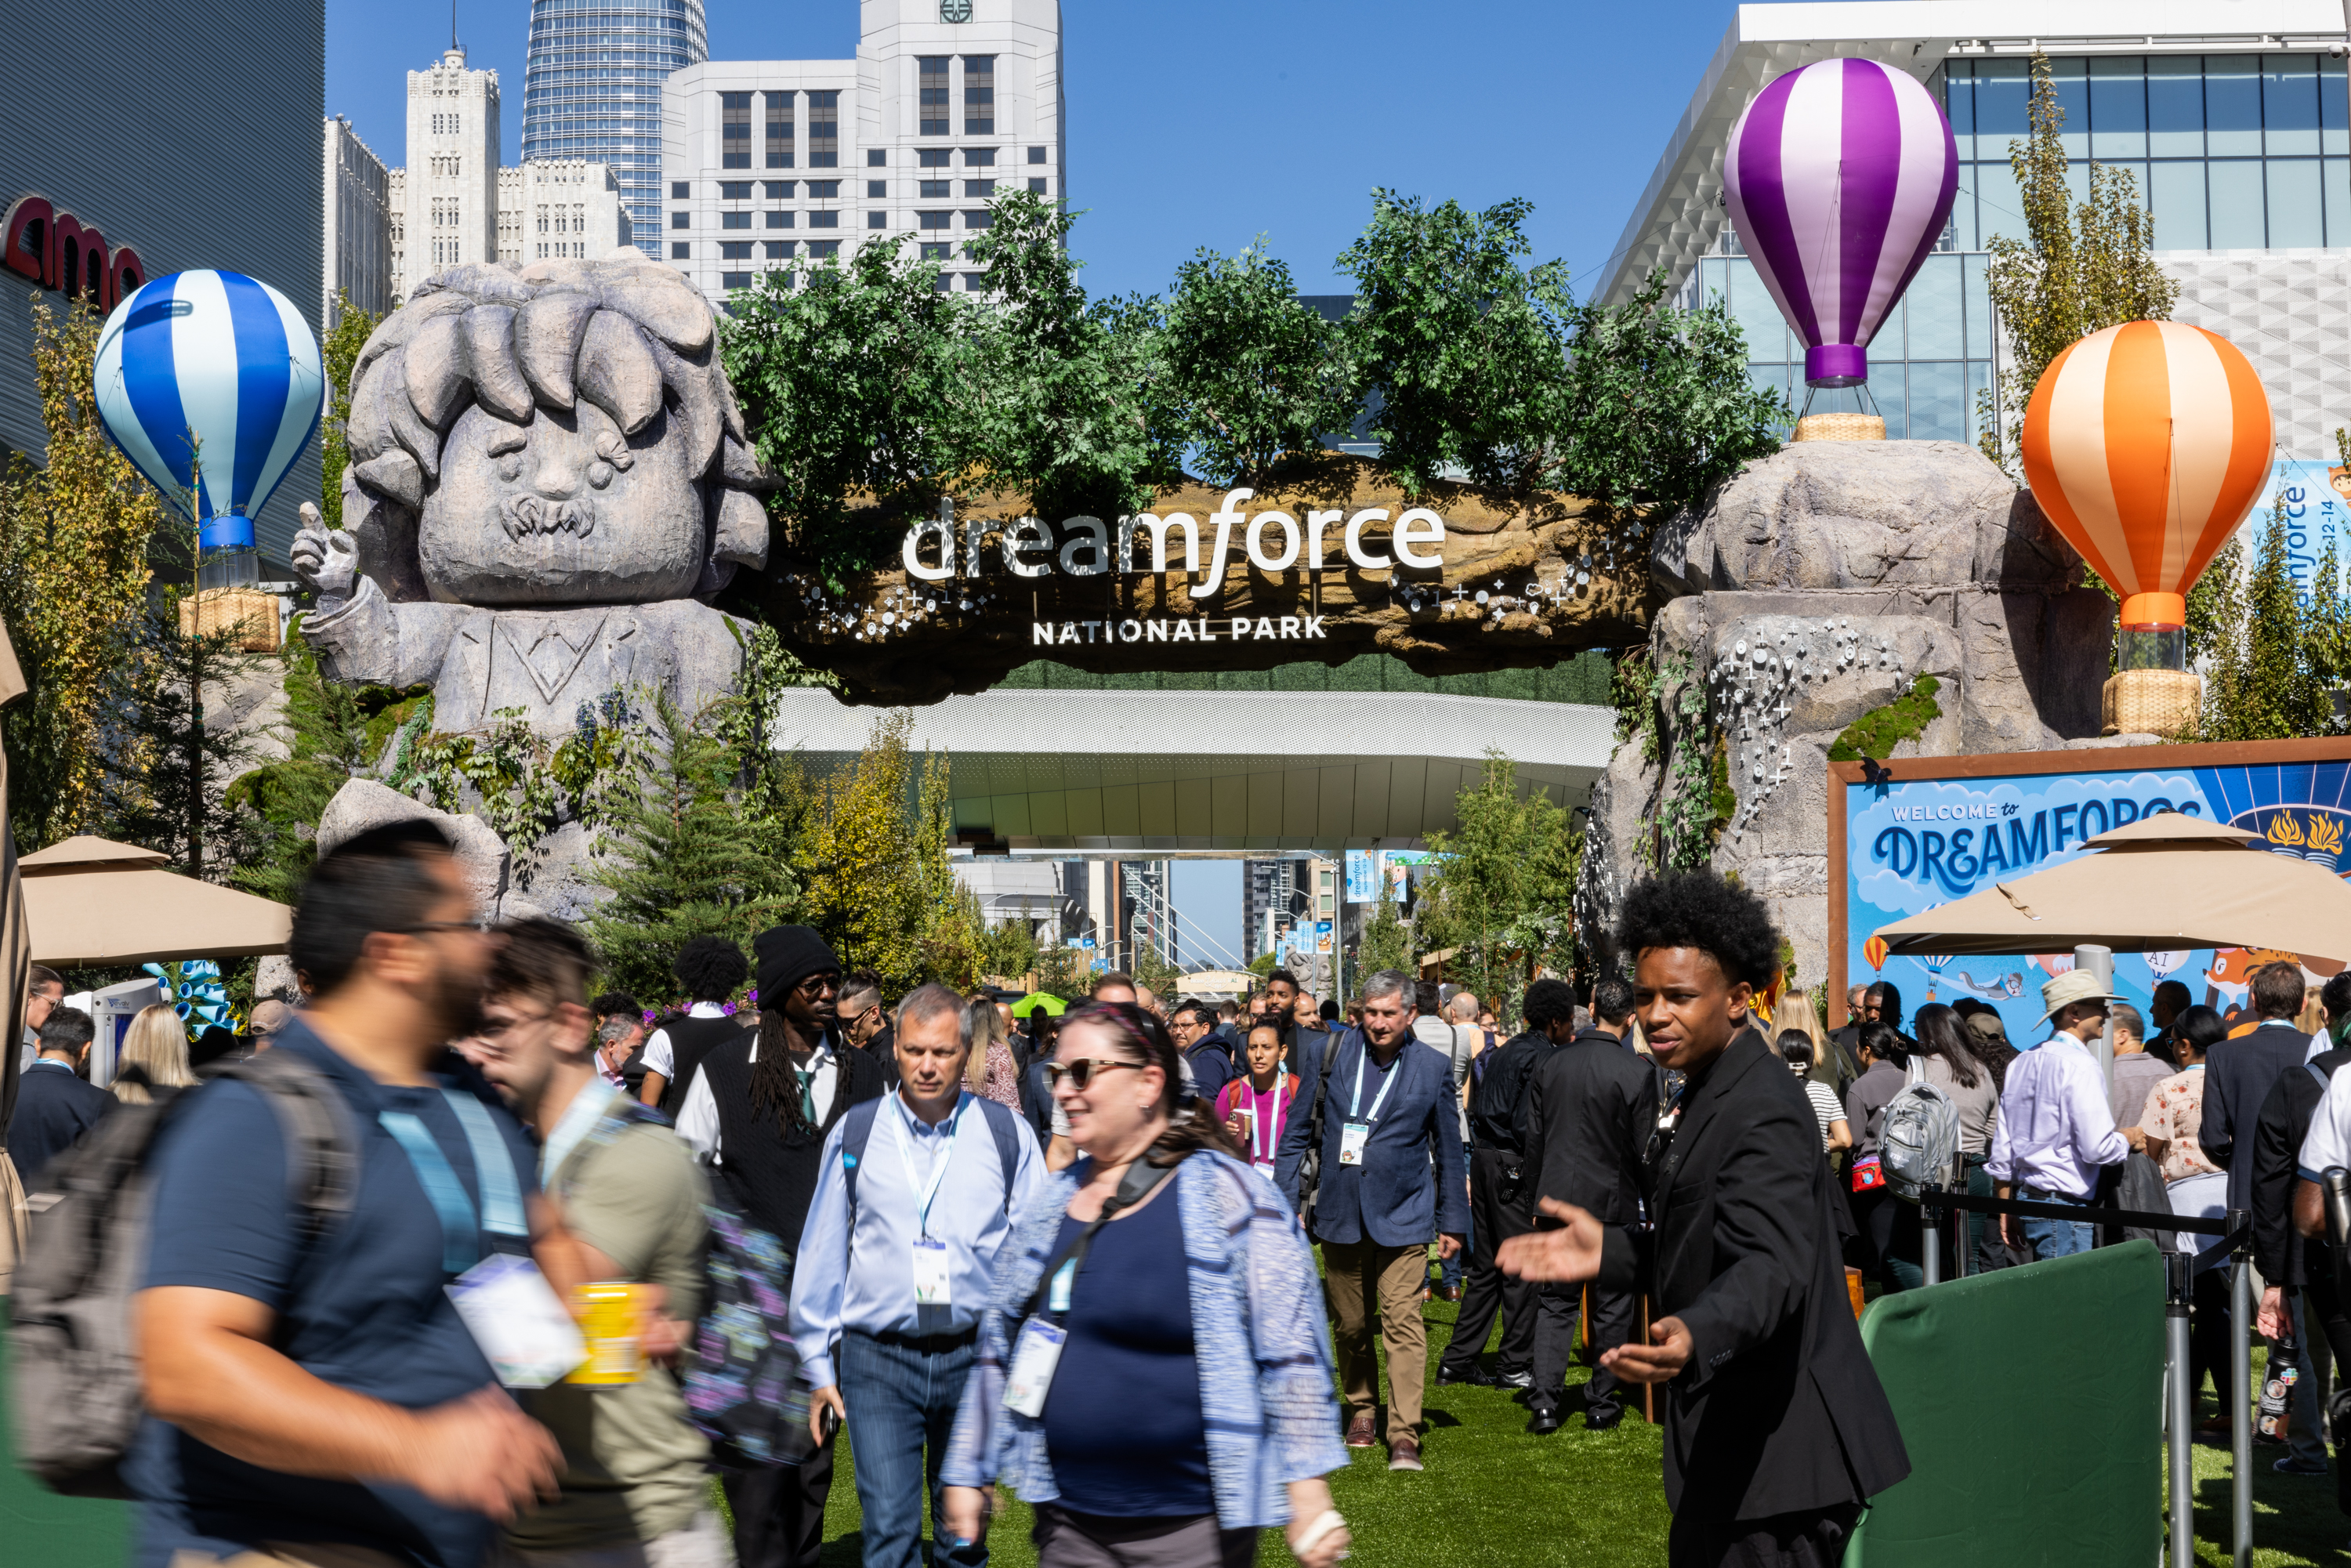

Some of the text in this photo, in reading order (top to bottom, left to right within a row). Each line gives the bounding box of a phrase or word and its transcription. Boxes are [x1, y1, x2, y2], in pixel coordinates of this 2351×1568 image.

[902, 487, 1446, 599] dreamforce
[1033, 614, 1327, 646] NATIONAL PARK
[1892, 802, 2020, 822] WELCOME to
[1353, 855, 1362, 898] dreamforce
[2148, 952, 2169, 967] AI
